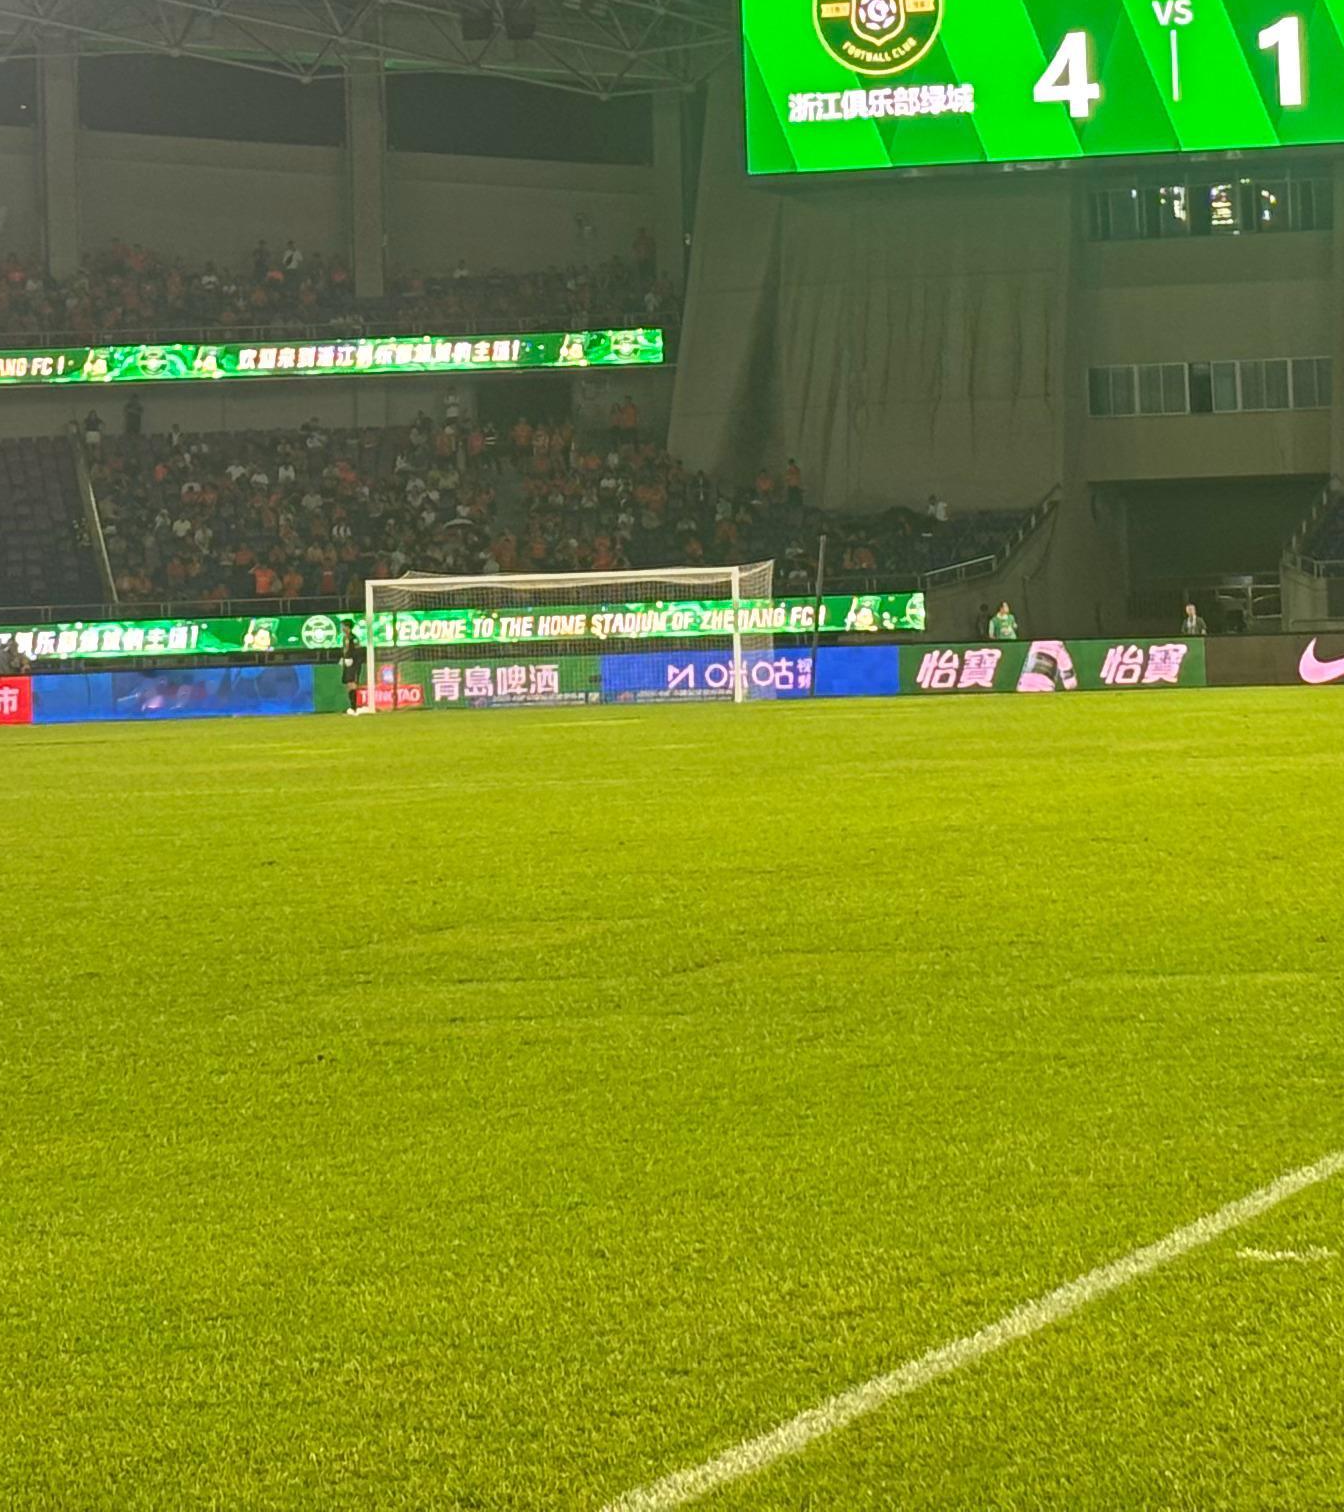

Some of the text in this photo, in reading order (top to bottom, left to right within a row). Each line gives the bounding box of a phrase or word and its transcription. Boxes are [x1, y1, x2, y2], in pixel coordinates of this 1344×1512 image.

[842, 37, 918, 62] FOOTBALL CLUB
[1258, 16, 1301, 105] 1
[1033, 31, 1100, 117] 4
[788, 83, 974, 122] 浙江俱乐部绿城
[385, 619, 467, 642] WELCOME
[472, 617, 495, 638] TO
[499, 615, 535, 637] THE
[537, 614, 587, 636] HOME
[591, 610, 669, 634] STADIUM
[671, 610, 695, 631] OF
